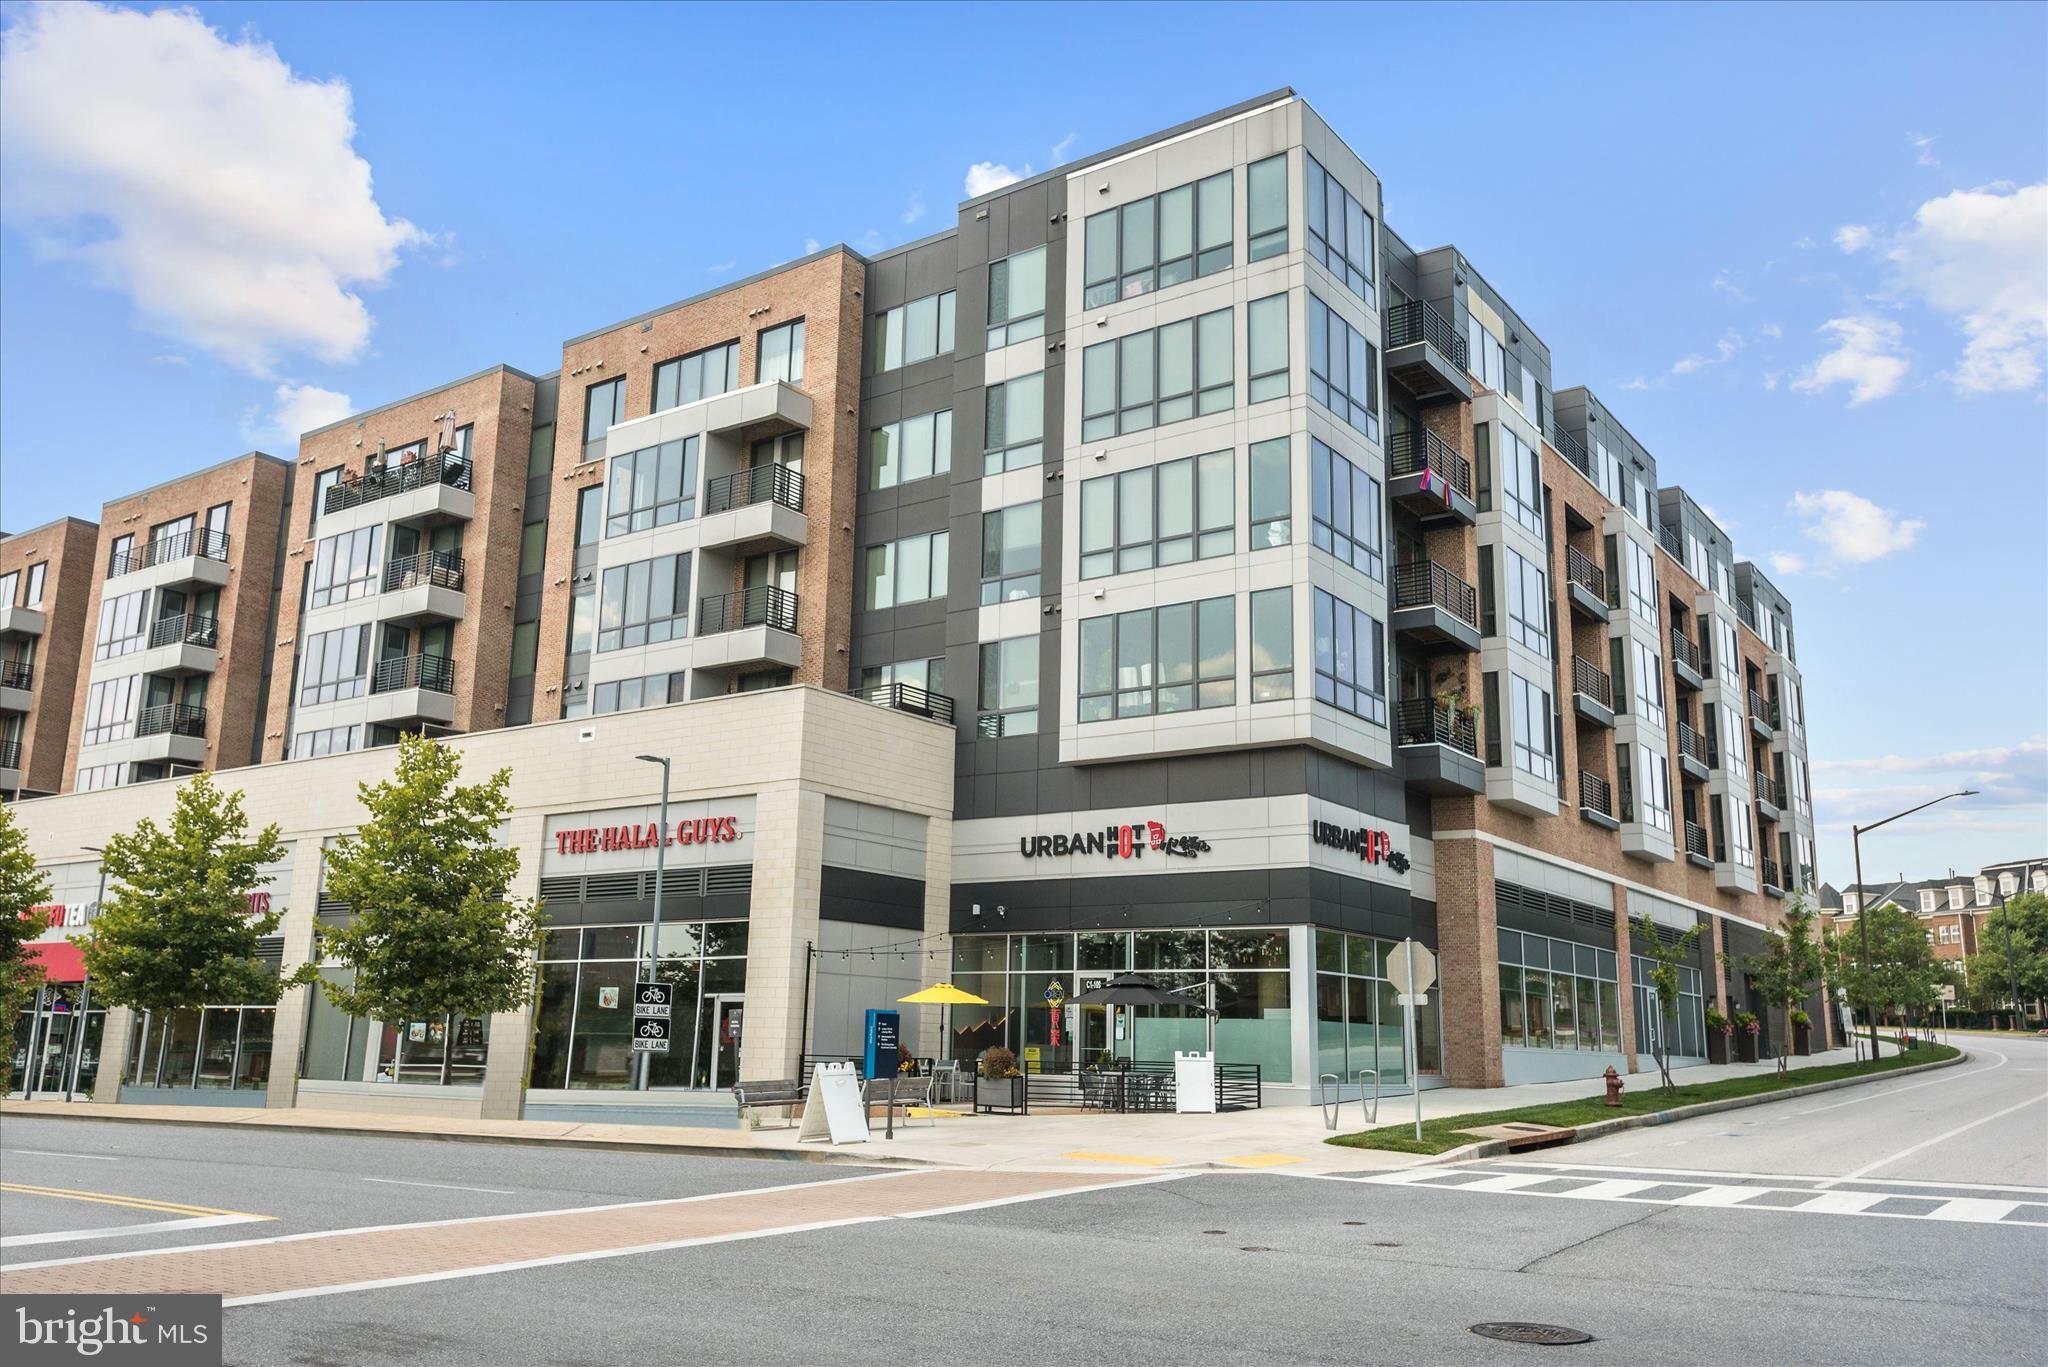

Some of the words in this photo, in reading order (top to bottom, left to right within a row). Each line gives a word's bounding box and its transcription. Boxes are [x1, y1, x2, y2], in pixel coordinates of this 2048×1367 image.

[556, 828, 597, 855] THE
[1020, 832, 1104, 858] URBAN
[1313, 820, 1360, 854] URBAN
[64, 904, 86, 927] TEA
[637, 1005, 650, 1015] BIKE
[653, 1006, 669, 1015] LANE
[635, 1040, 649, 1049] BIKE
[651, 1041, 667, 1050] LANE
